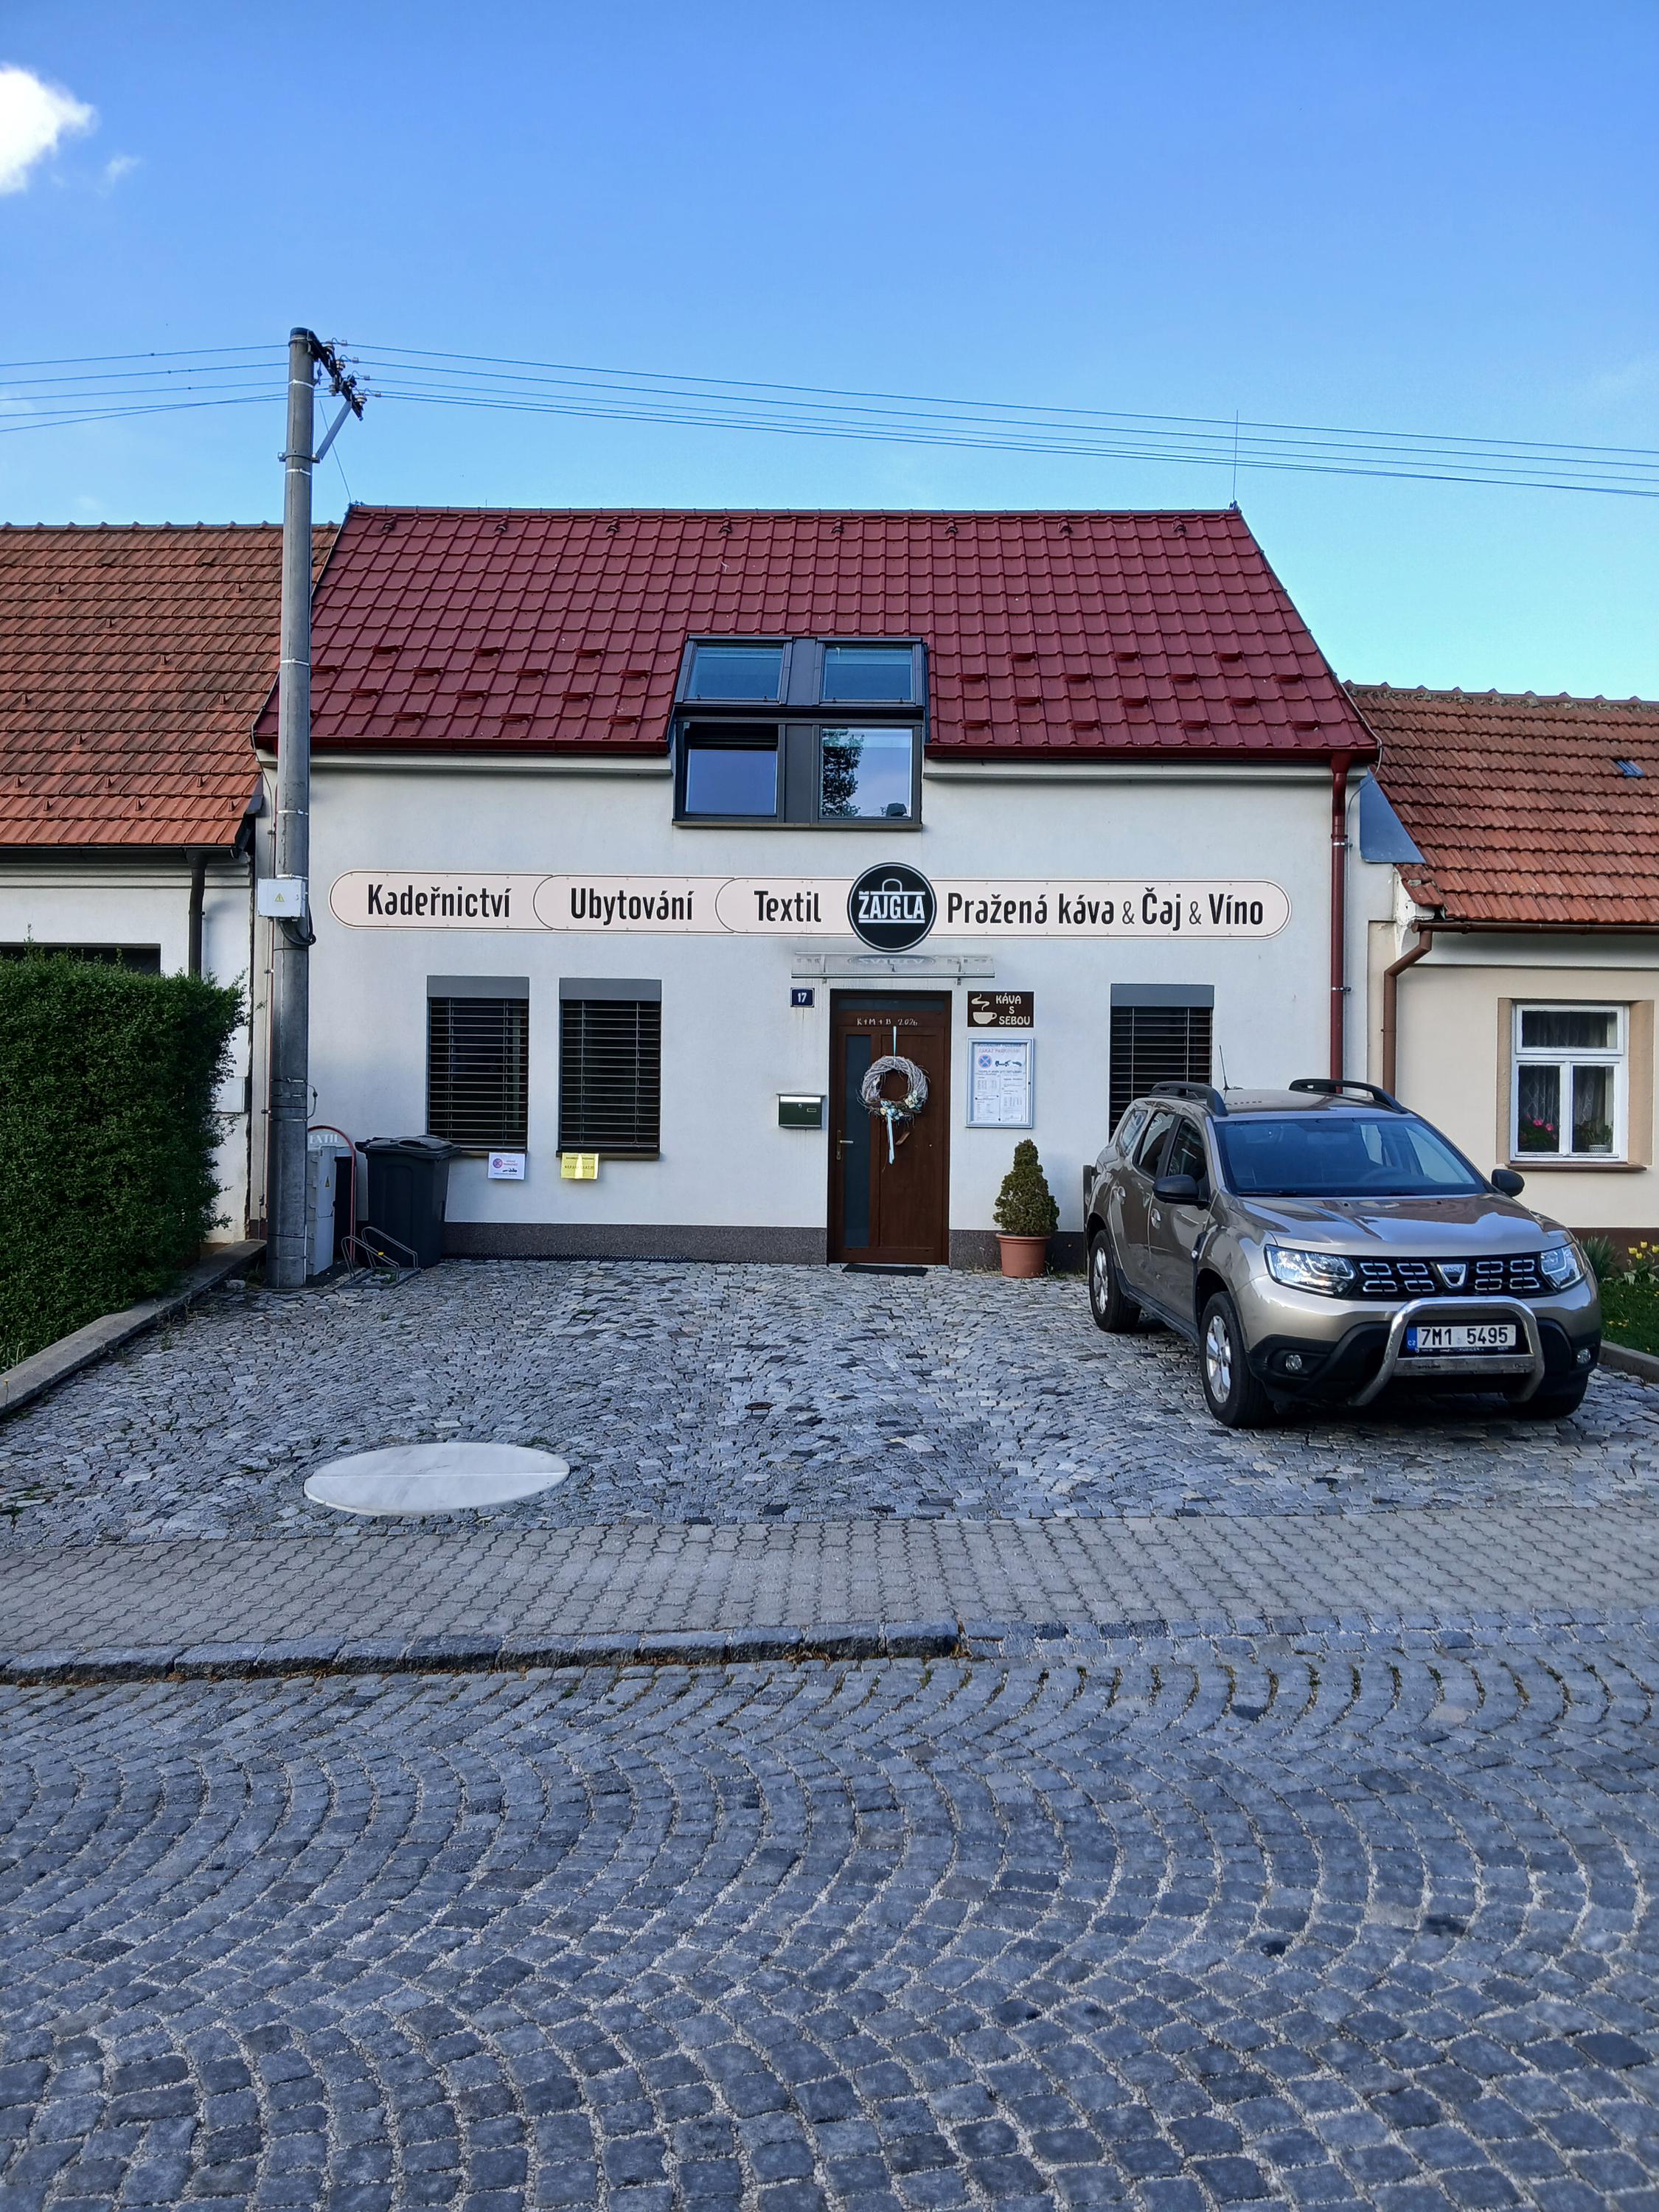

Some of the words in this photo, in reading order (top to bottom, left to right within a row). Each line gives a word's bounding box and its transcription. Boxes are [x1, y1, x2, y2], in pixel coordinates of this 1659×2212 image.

[368, 884, 512, 918] Kadeřnictví
[571, 888, 695, 926] Ubytování
[754, 890, 821, 922] Textil
[858, 891, 925, 919] ŽAJGLA
[947, 892, 1048, 925] Pražená
[1058, 893, 1114, 925] káva
[1121, 901, 1135, 925] &
[1142, 887, 1182, 931] Čaj
[1189, 901, 1202, 925] &
[1208, 893, 1263, 925] Víno
[798, 992, 807, 1003] 17
[995, 992, 1022, 1004] KÁVA
[1009, 1006, 1015, 1015] S
[998, 1015, 1031, 1026] SEBOU
[310, 1134, 340, 1144] EXTIL
[1421, 1328, 1452, 1346] 7M1
[1467, 1327, 1509, 1345] 5495
